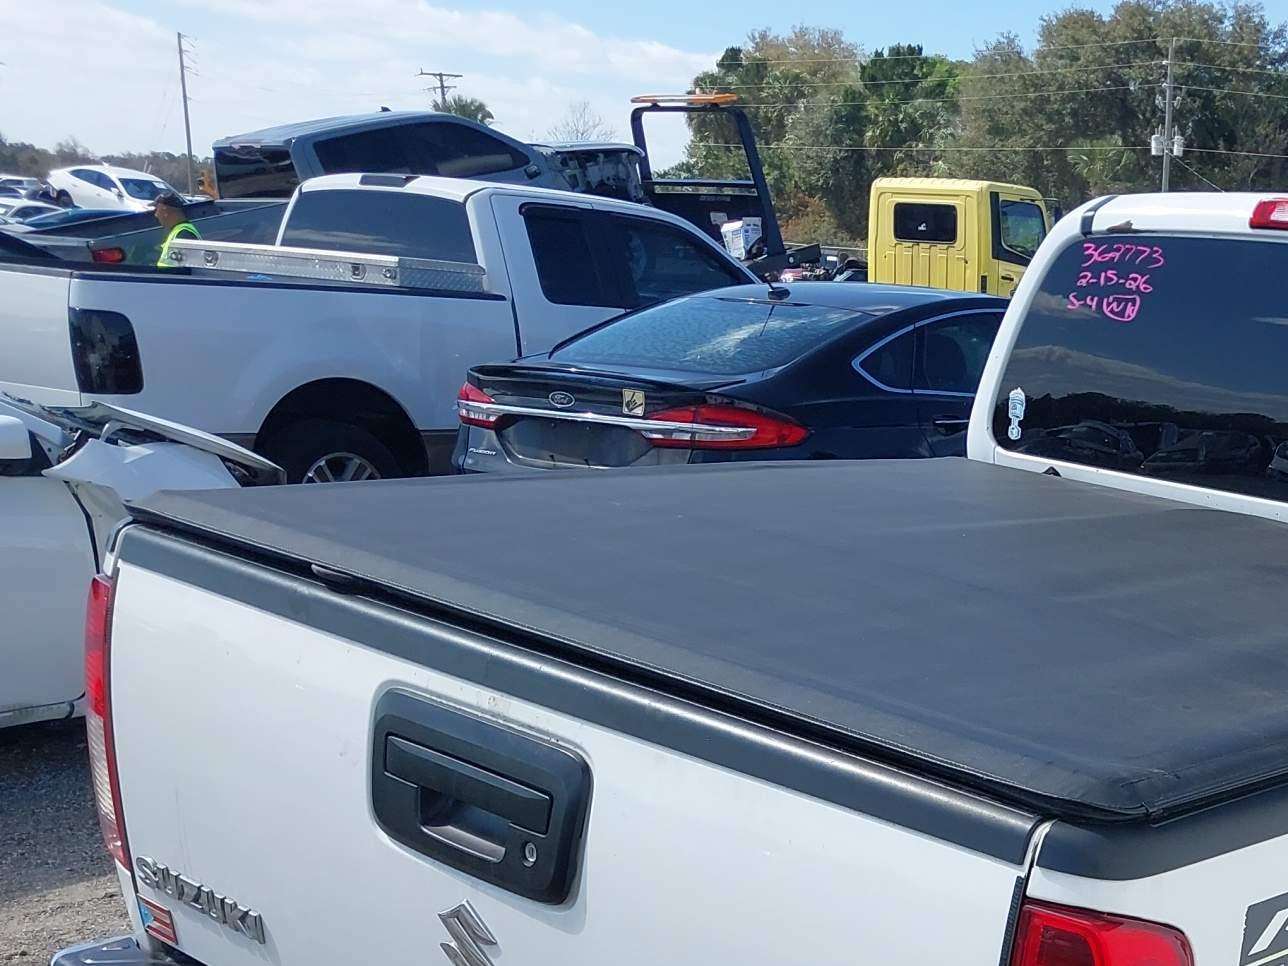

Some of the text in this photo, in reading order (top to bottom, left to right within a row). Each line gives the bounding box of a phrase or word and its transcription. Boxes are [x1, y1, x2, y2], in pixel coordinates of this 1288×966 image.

[1081, 243, 1165, 269] 362773
[1076, 269, 1153, 293] 2-15-26
[135, 855, 266, 945] SUZUKI
